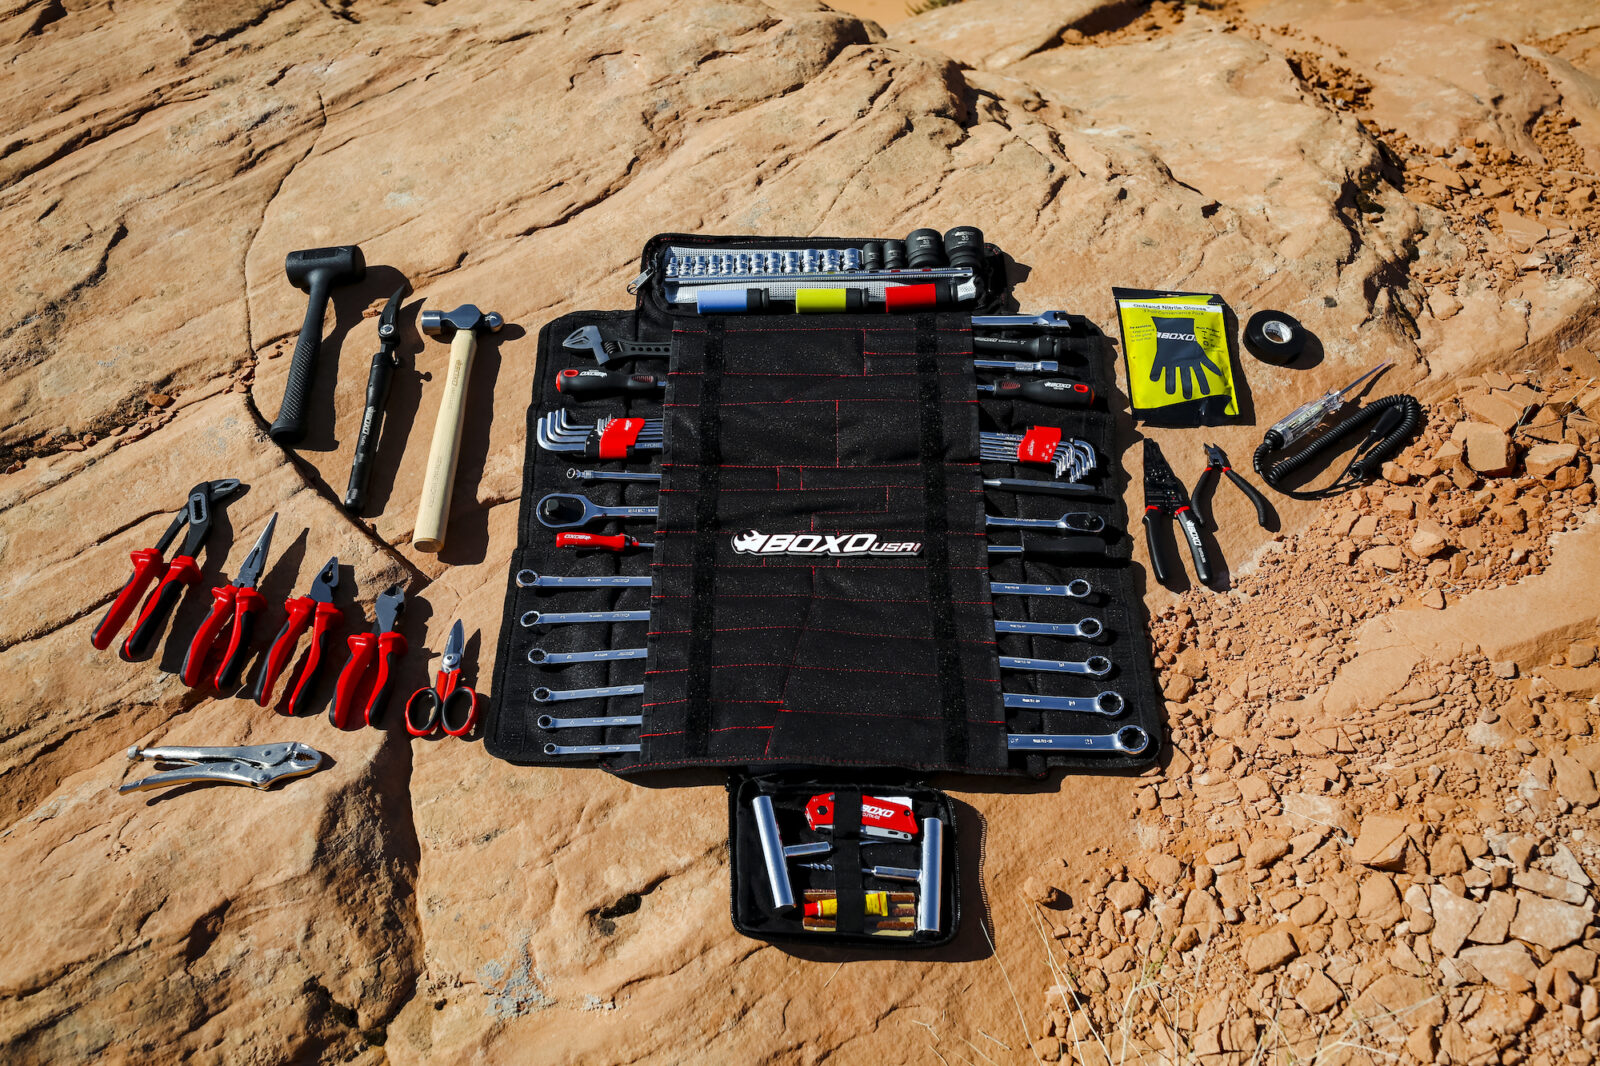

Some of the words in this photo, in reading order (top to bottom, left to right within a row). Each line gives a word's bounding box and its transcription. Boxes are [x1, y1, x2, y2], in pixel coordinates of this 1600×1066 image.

[1161, 332, 1195, 341] BOXO
[760, 534, 877, 552] BOXO
[1187, 526, 1202, 546] BOXO
